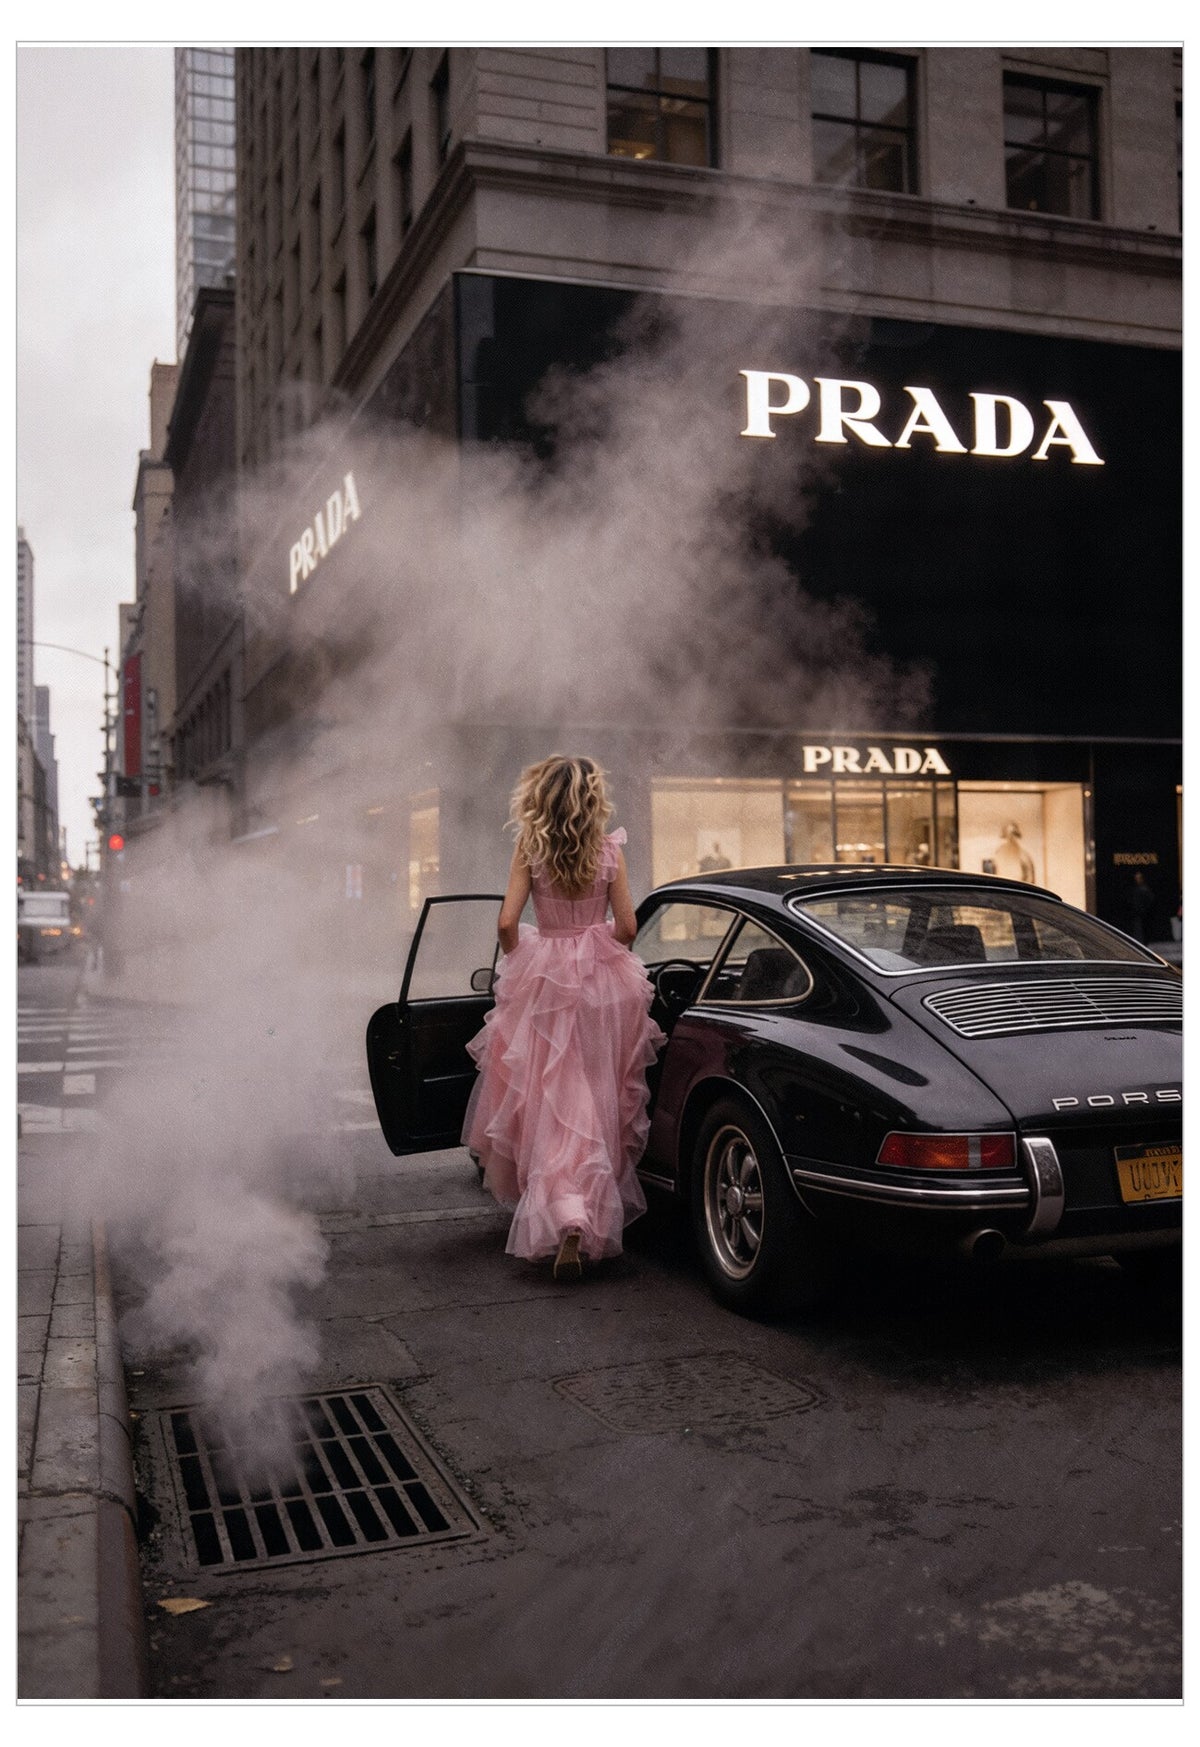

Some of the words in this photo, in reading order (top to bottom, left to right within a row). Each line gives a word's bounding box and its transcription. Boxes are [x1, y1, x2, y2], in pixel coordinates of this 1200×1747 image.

[739, 370, 1105, 465] PRADA
[289, 471, 361, 594] PRADA
[802, 745, 951, 775] PRADA
[1052, 1090, 1182, 1111] PORS
